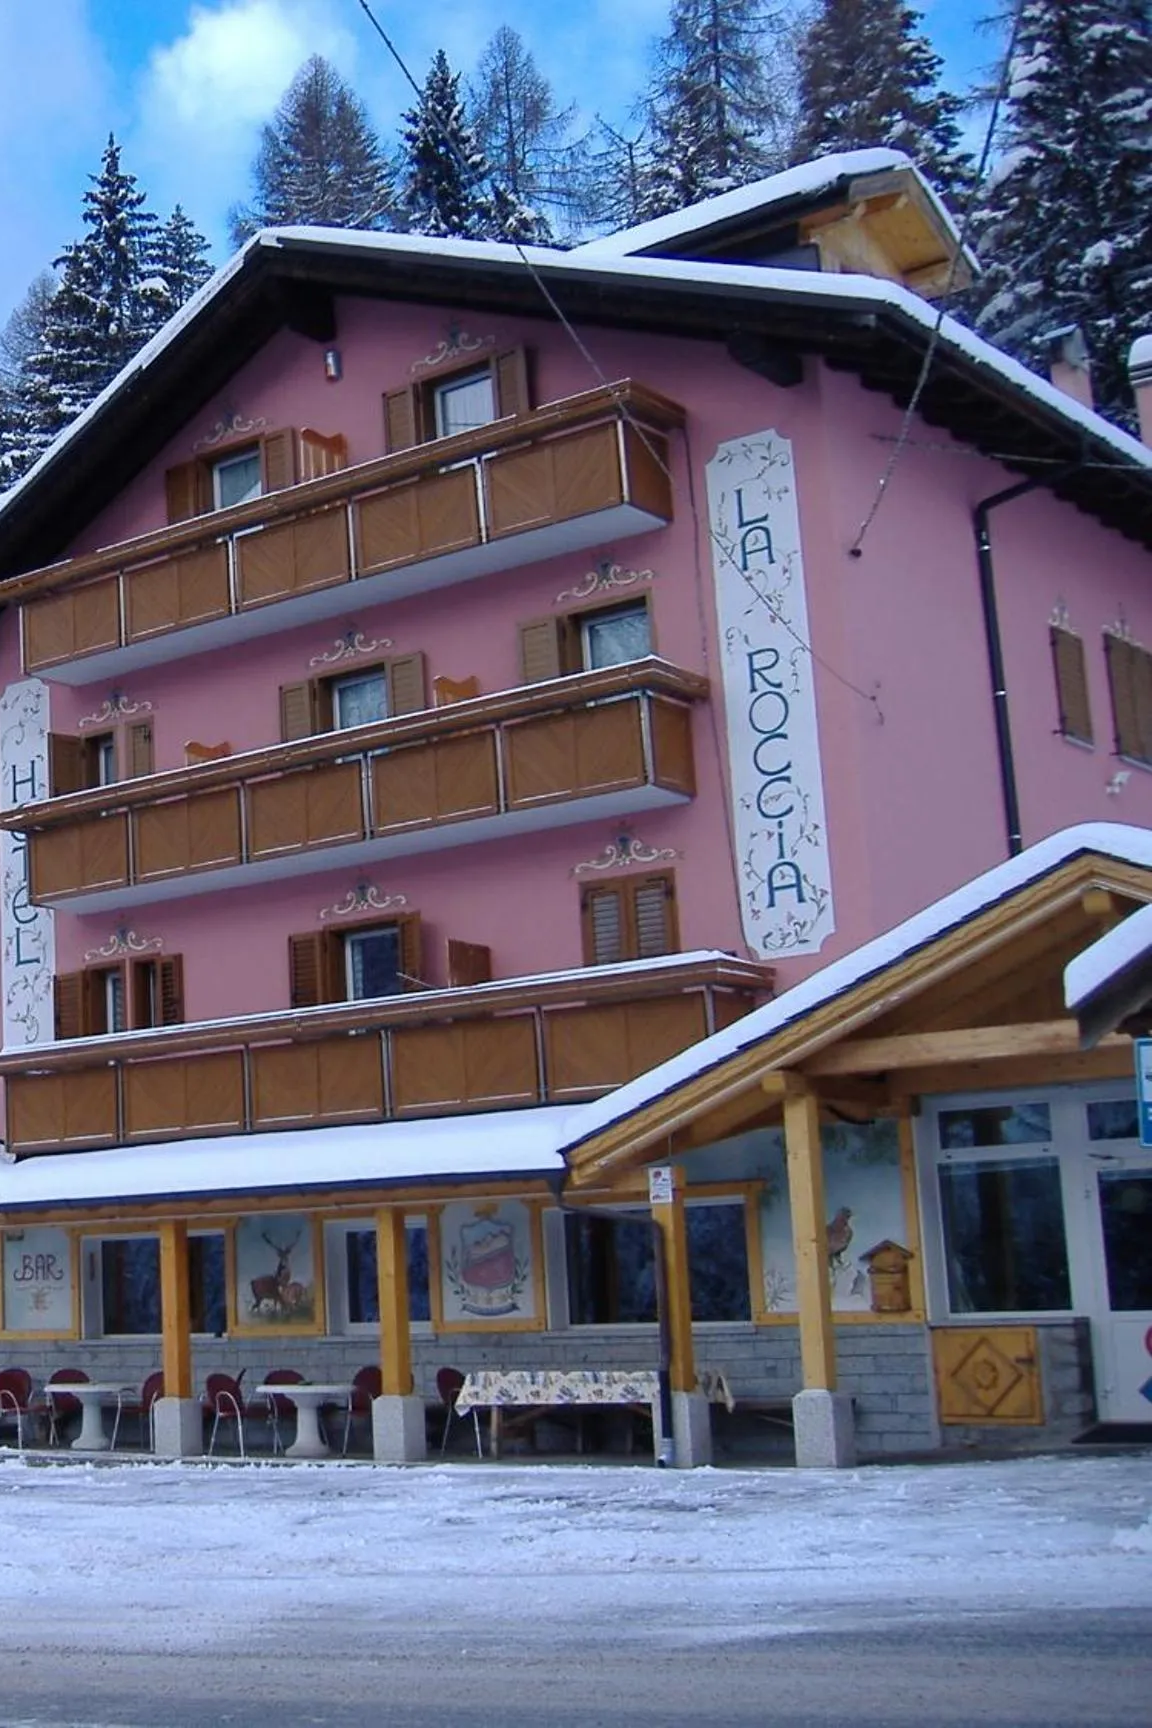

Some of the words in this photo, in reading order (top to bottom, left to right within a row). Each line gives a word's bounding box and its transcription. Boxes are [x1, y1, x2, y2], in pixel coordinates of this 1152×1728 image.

[734, 487, 775, 571] LA
[11, 760, 41, 967] HTEL
[13, 1253, 64, 1281] BAR
